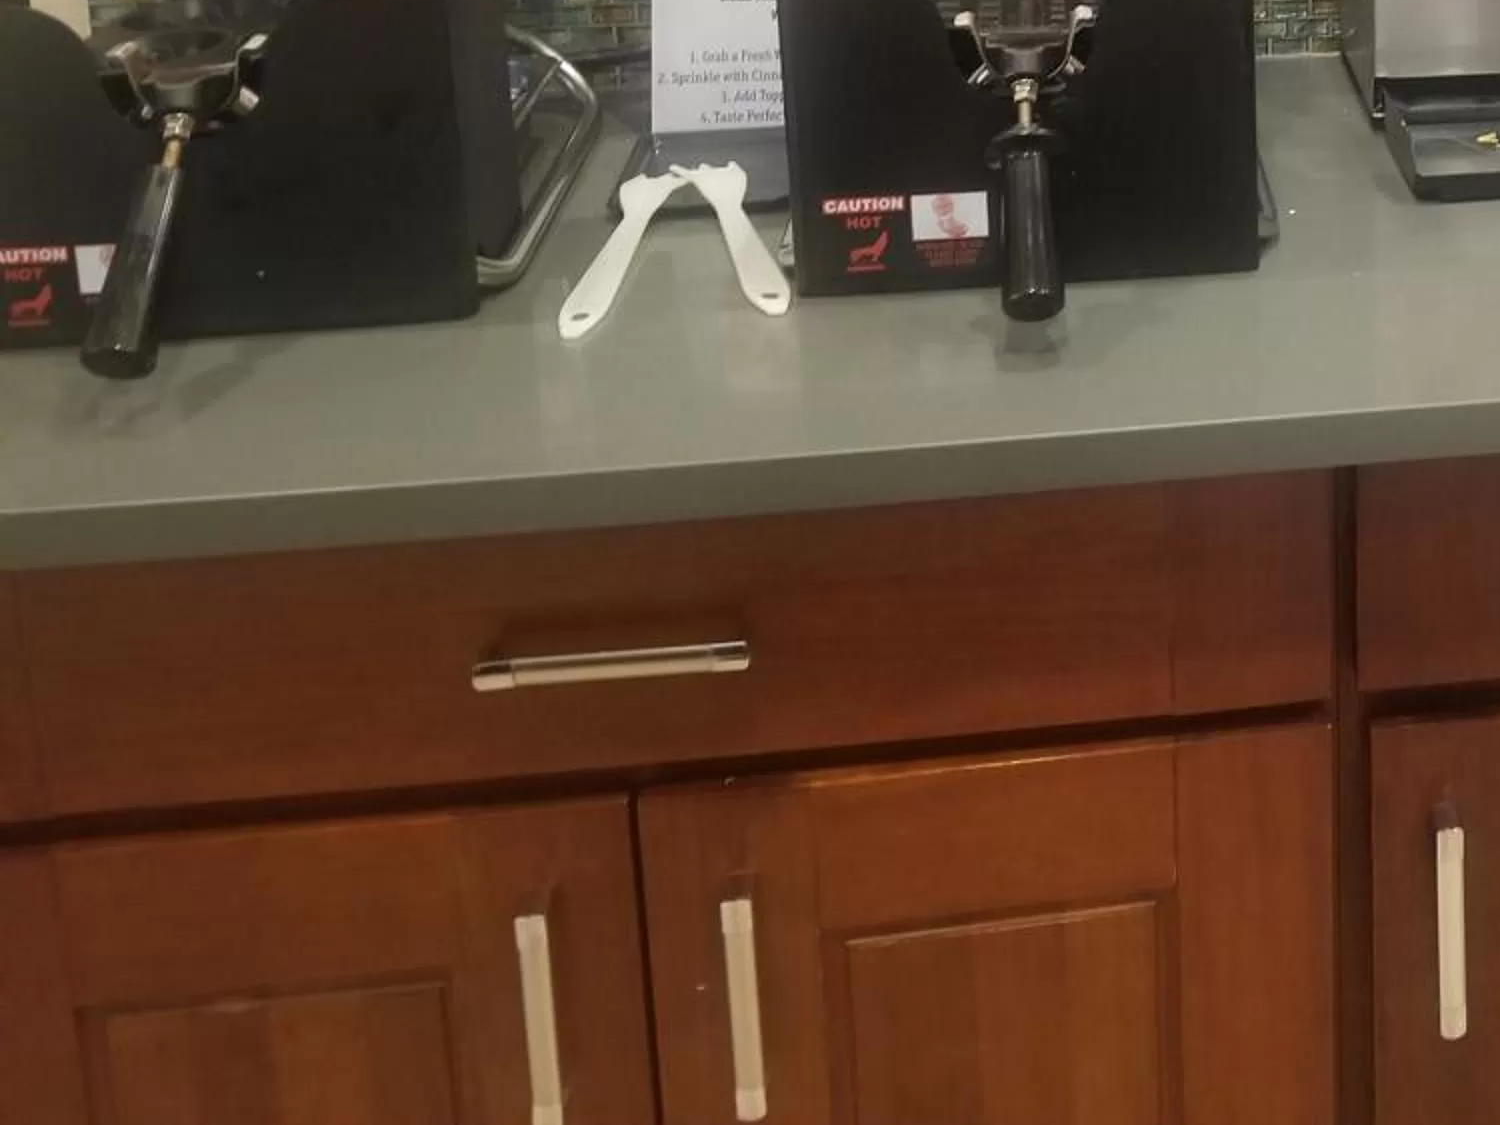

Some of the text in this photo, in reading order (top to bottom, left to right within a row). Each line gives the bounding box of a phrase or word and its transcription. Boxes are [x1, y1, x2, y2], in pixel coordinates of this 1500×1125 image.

[671, 69, 721, 87] Sprinkle
[722, 69, 749, 82] with
[821, 195, 905, 215] CAUTION
[846, 216, 883, 230] HOT
[4, 267, 44, 282] HOT
